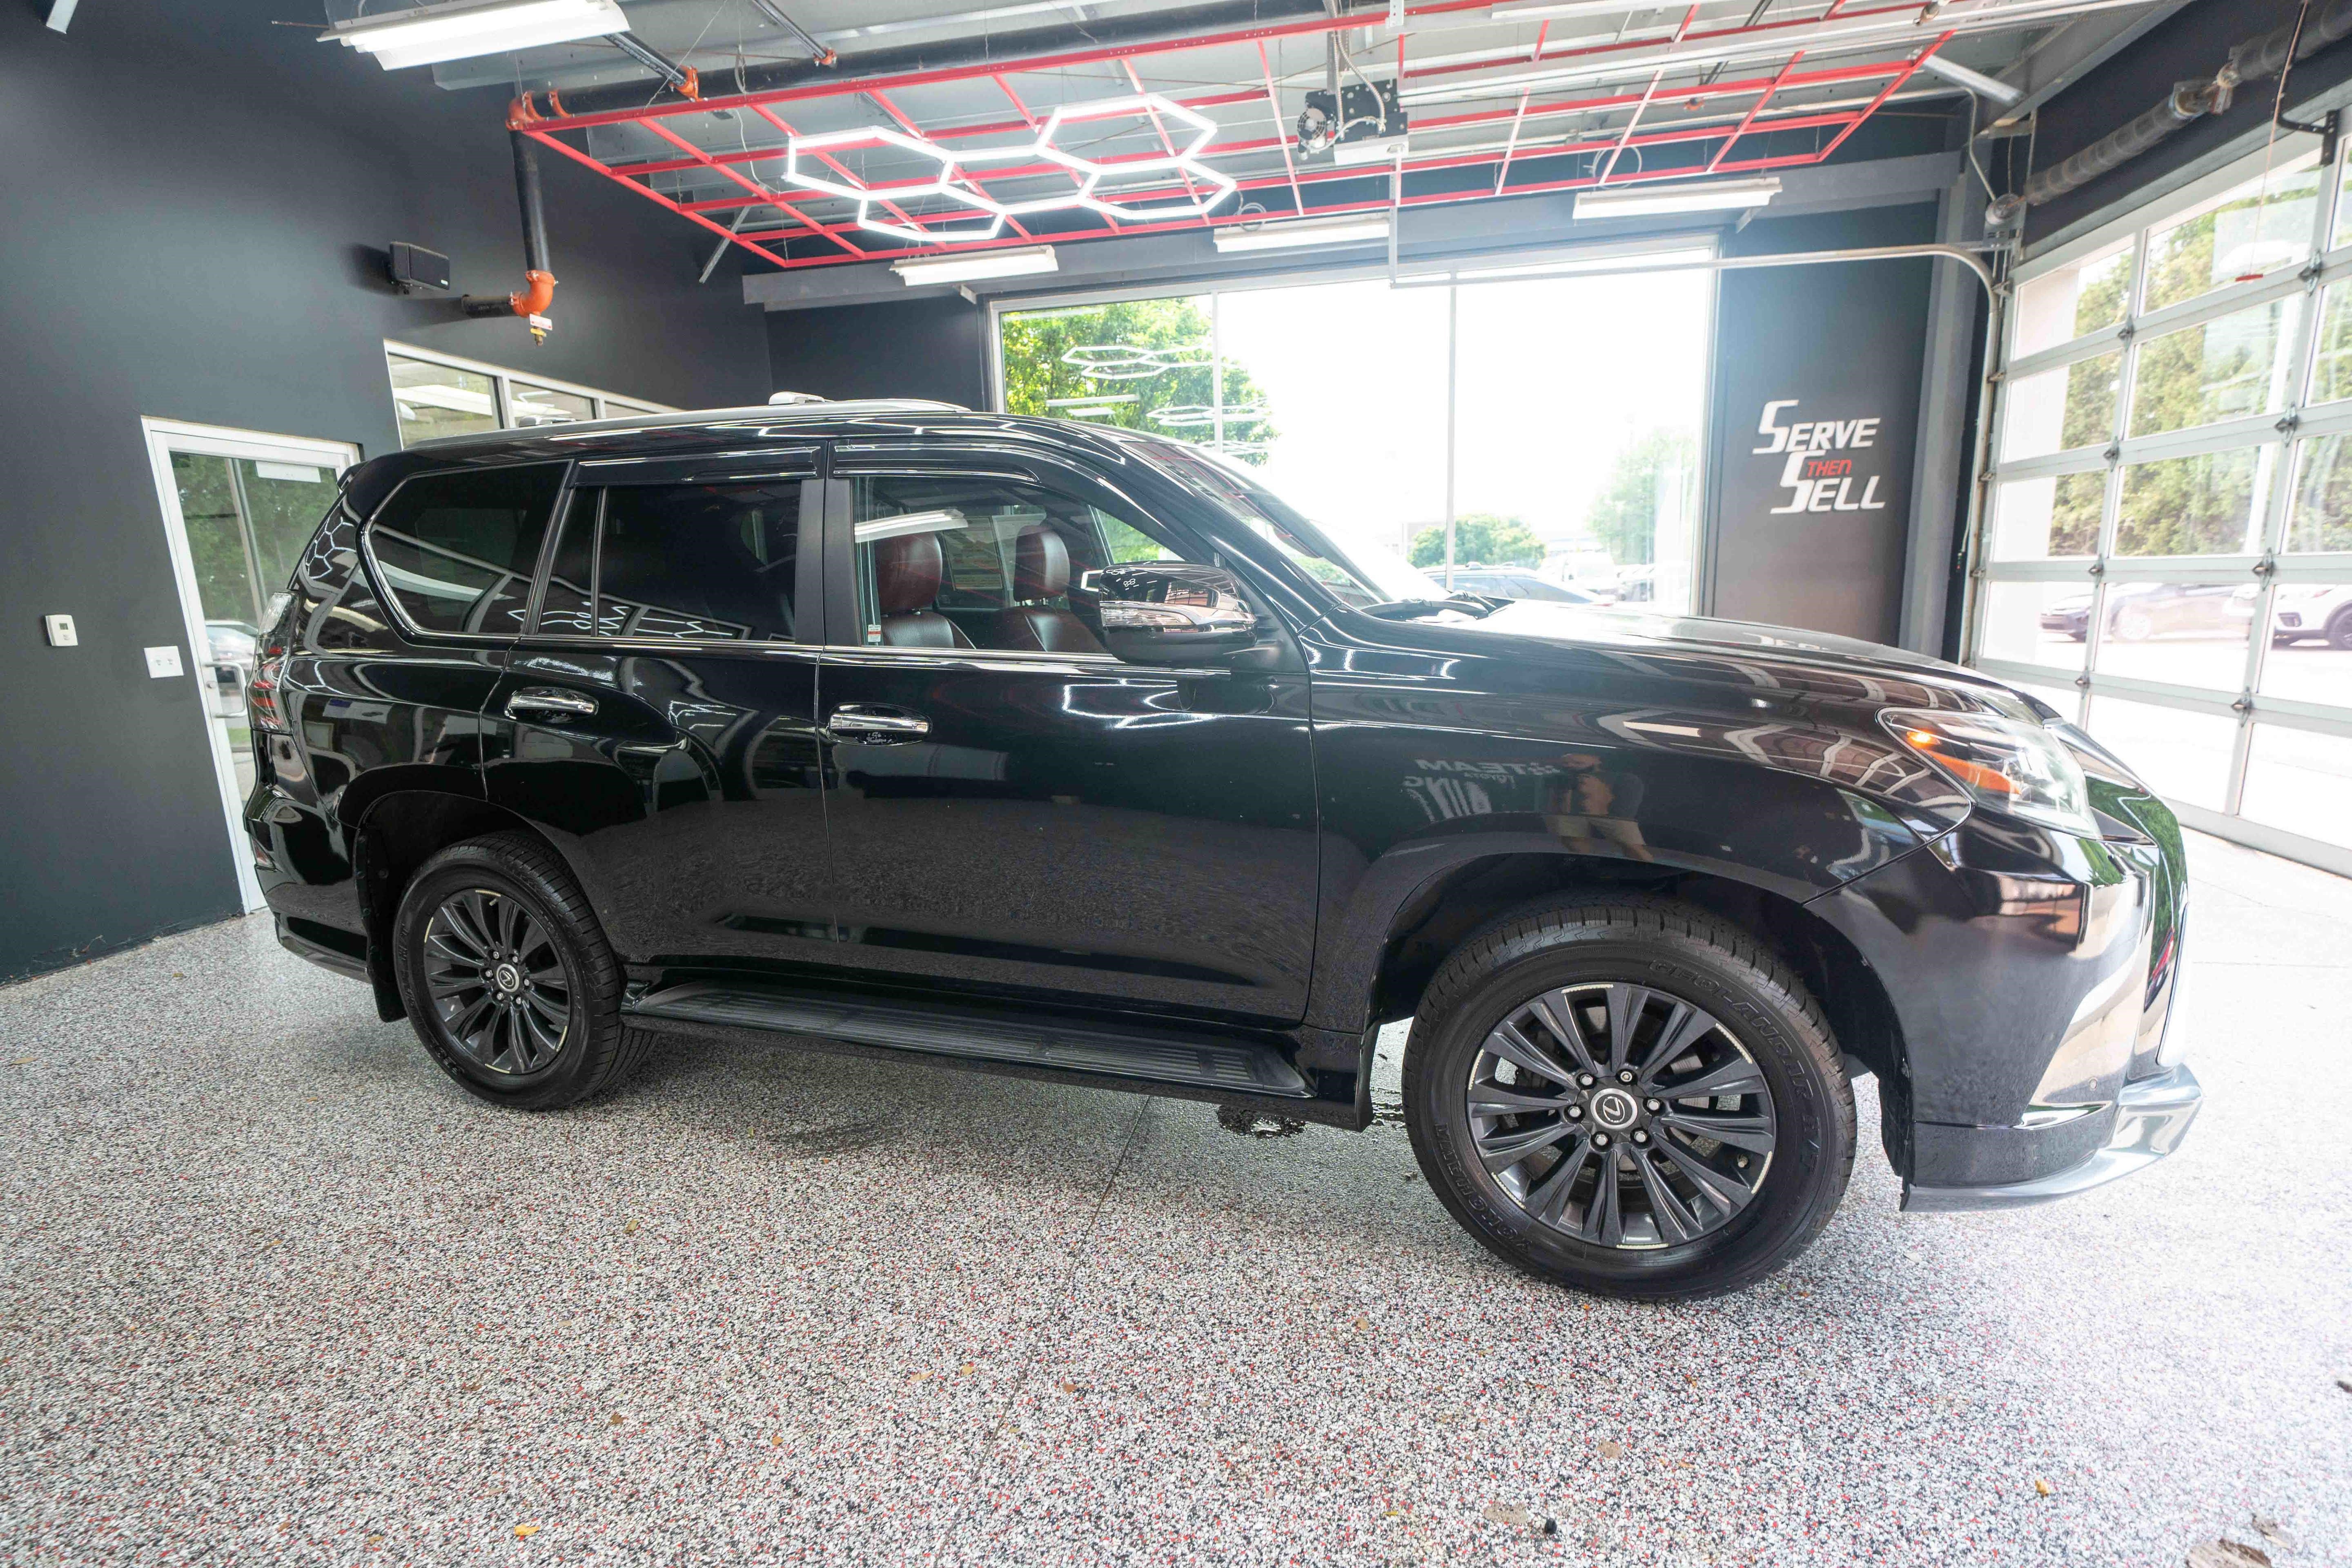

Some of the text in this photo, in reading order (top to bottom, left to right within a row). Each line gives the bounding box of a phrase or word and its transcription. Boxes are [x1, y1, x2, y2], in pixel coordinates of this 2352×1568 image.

[1752, 399, 1880, 454] SERVE
[1770, 450, 1885, 514] SELL
[1807, 459, 1852, 477] THEN
[1648, 960, 1814, 1099] GEOLANDAR
